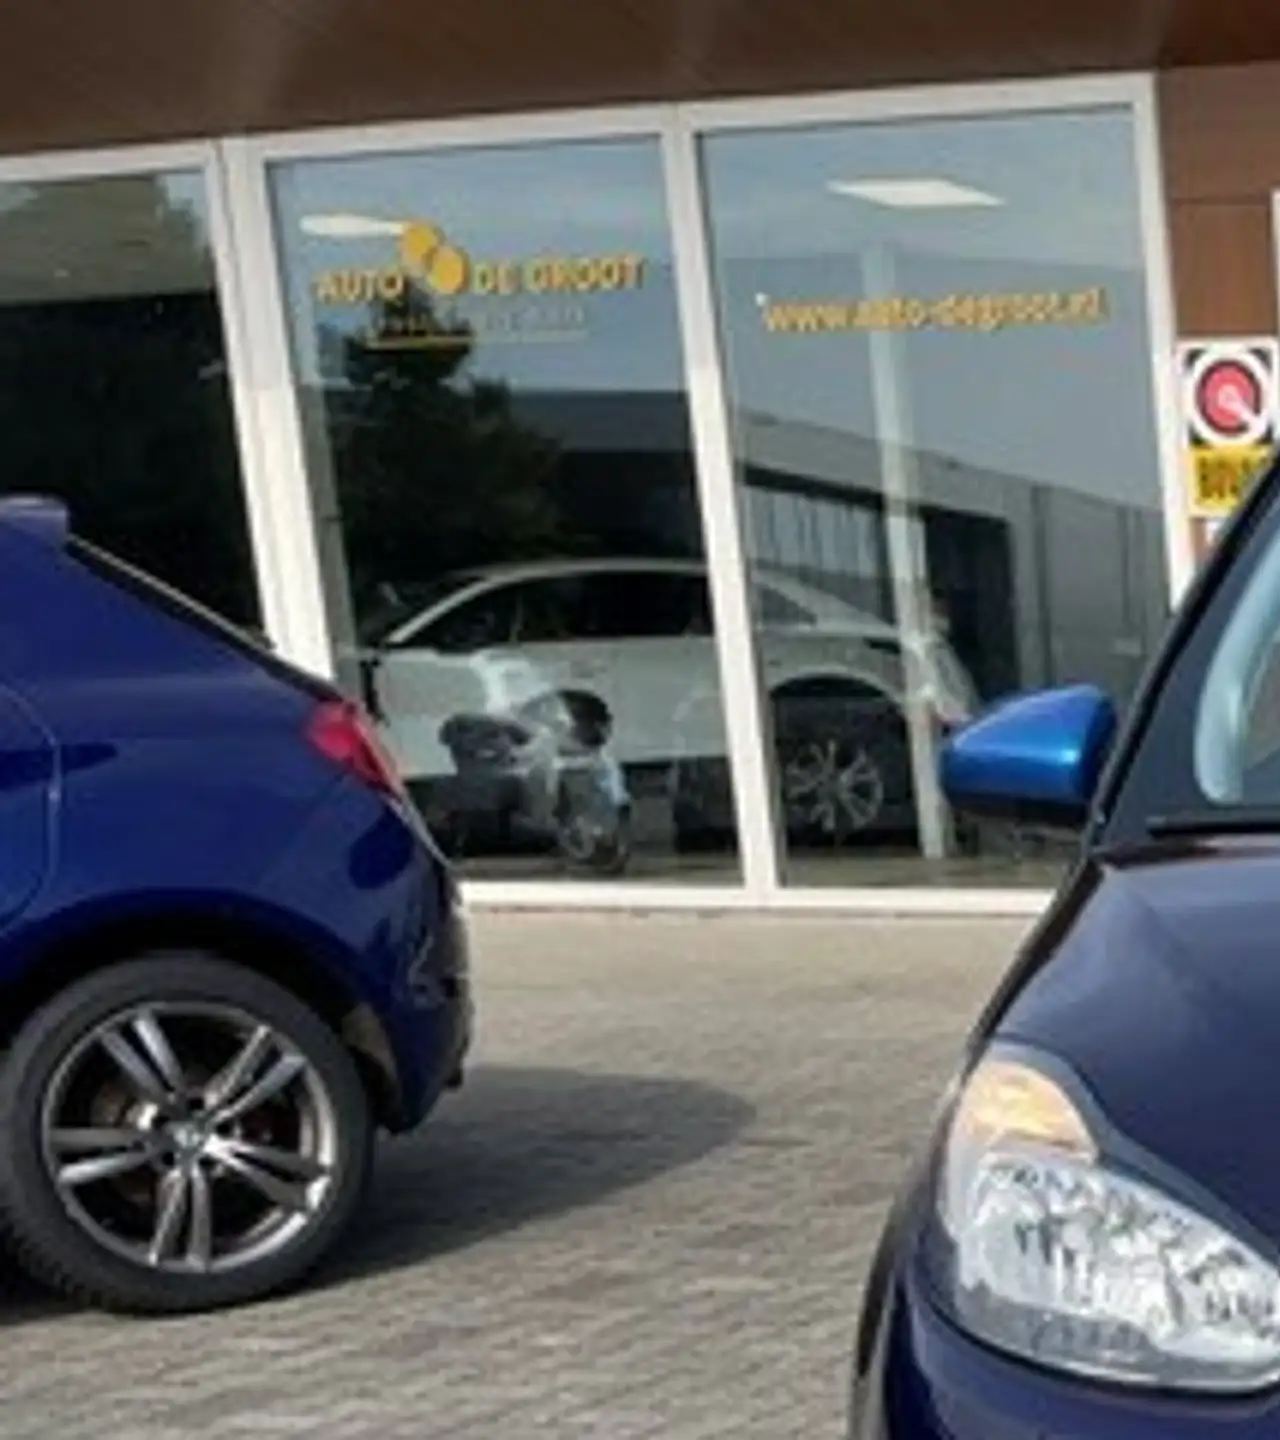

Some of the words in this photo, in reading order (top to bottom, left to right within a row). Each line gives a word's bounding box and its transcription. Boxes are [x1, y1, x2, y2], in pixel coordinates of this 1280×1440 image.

[313, 270, 404, 303] AUTO
[471, 261, 518, 293] DE
[527, 254, 648, 291] GROOT
